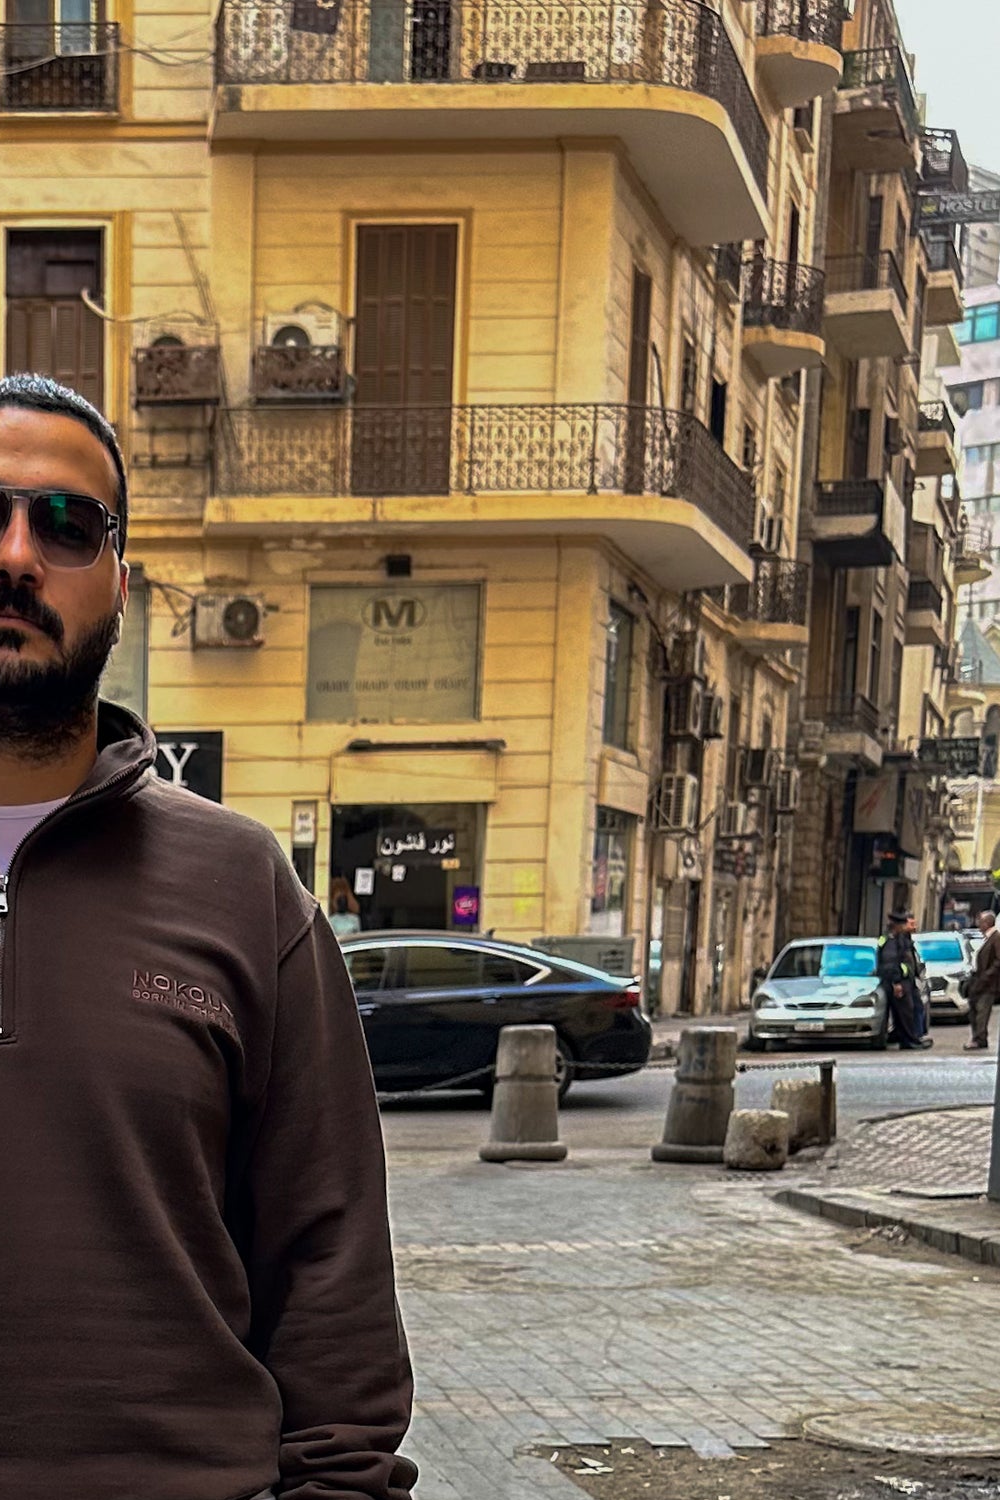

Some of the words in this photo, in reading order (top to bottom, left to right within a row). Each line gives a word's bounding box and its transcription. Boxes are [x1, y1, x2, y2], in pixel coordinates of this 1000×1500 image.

[371, 600, 417, 628] M
[143, 741, 200, 788] Y
[428, 833, 456, 855] نور
